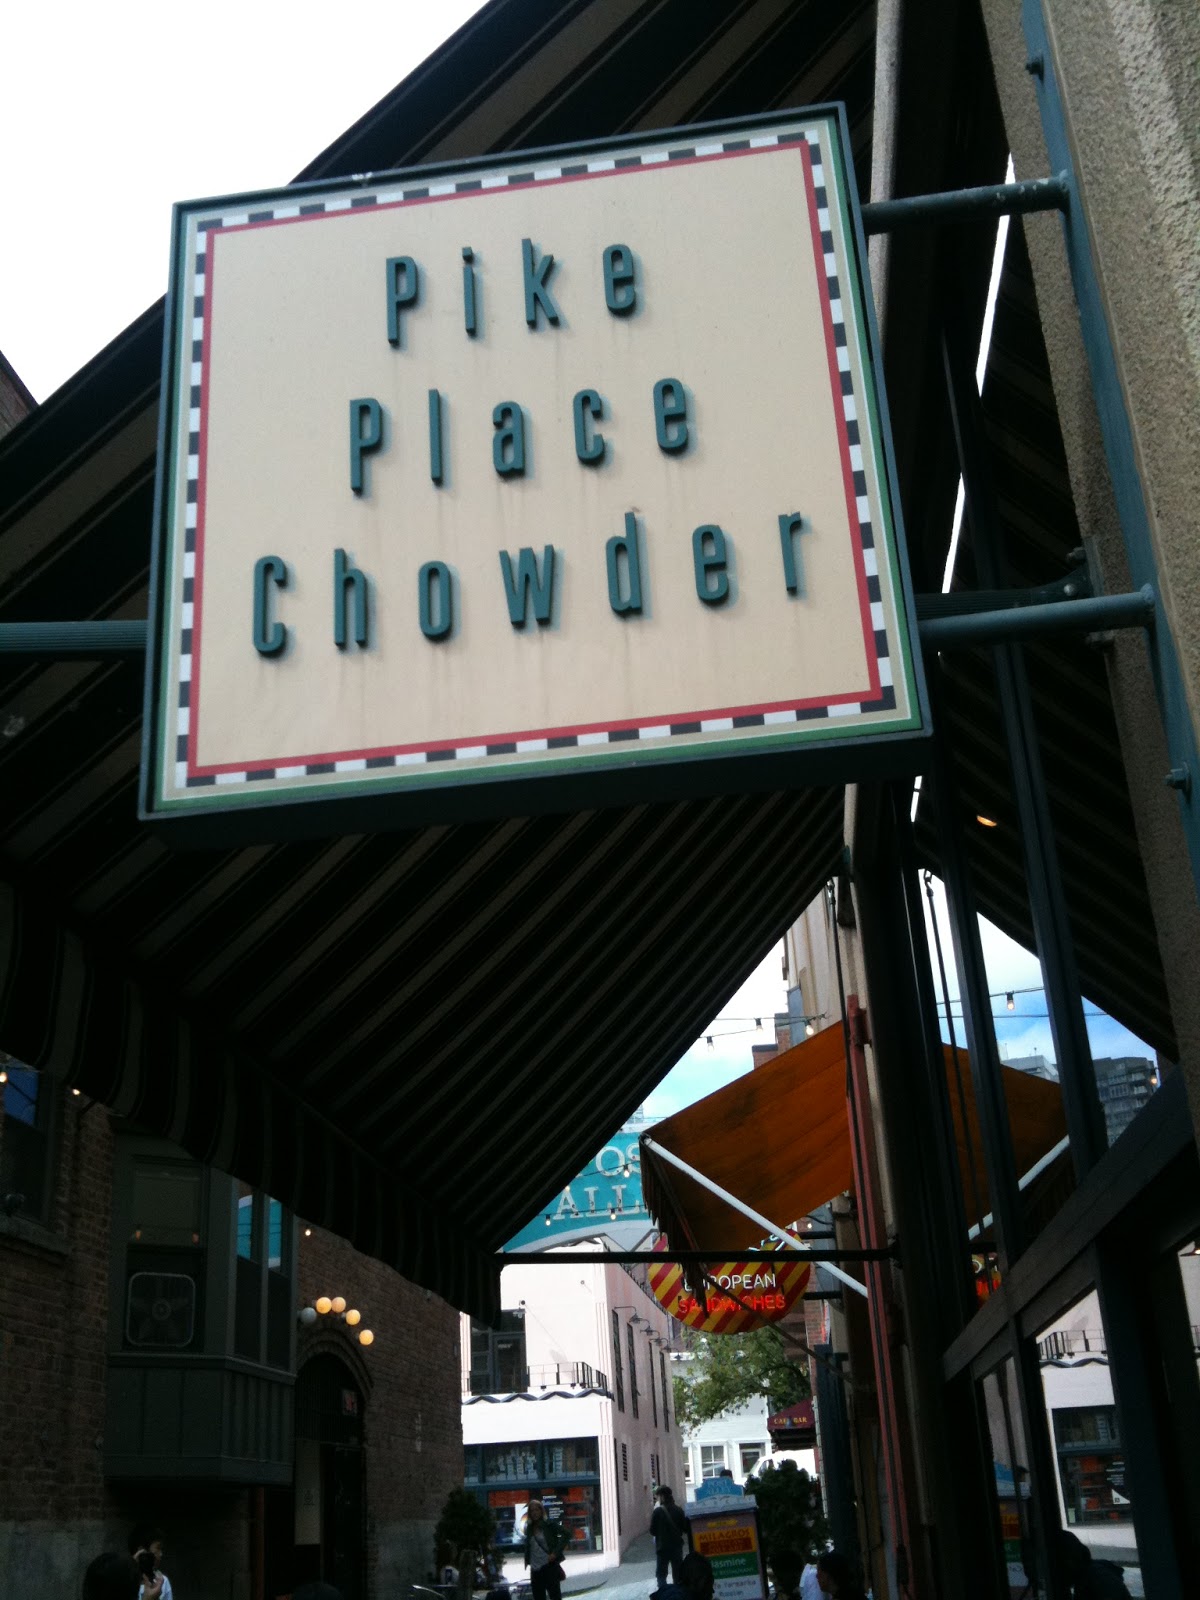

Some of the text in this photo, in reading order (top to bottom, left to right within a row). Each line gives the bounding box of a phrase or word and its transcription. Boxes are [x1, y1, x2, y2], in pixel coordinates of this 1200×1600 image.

[386, 238, 638, 347] Pike
[349, 378, 690, 496] Place
[252, 511, 803, 658] Chowder
